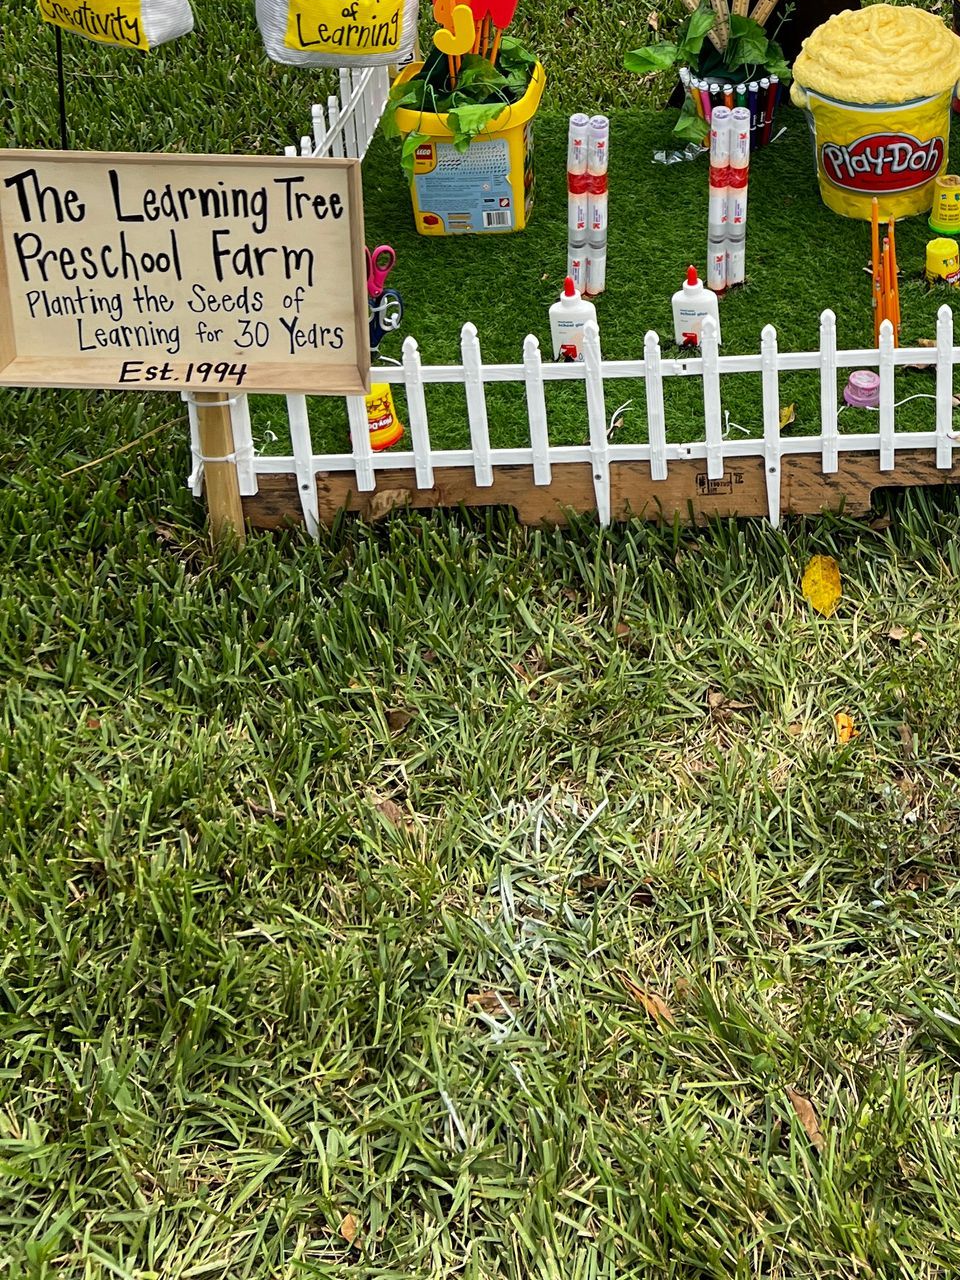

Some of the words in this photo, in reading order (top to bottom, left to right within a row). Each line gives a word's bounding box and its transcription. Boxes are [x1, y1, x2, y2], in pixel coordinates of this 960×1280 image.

[296, 9, 399, 48] Learning
[341, 2, 359, 21] of
[416, 148, 432, 156] LEGO
[824, 137, 939, 179] Play-Doh
[4, 169, 86, 223] The
[109, 169, 268, 234] Learning
[273, 176, 344, 221] Tree
[14, 229, 182, 281] Preschool
[212, 229, 314, 286] Farm
[26, 285, 124, 321] Planting
[133, 284, 175, 313] the
[187, 284, 263, 312] Seeds
[283, 286, 306, 313] of
[77, 319, 180, 354] Learning
[196, 322, 224, 342] for
[233, 320, 270, 348] 30
[279, 316, 344, 354] Years
